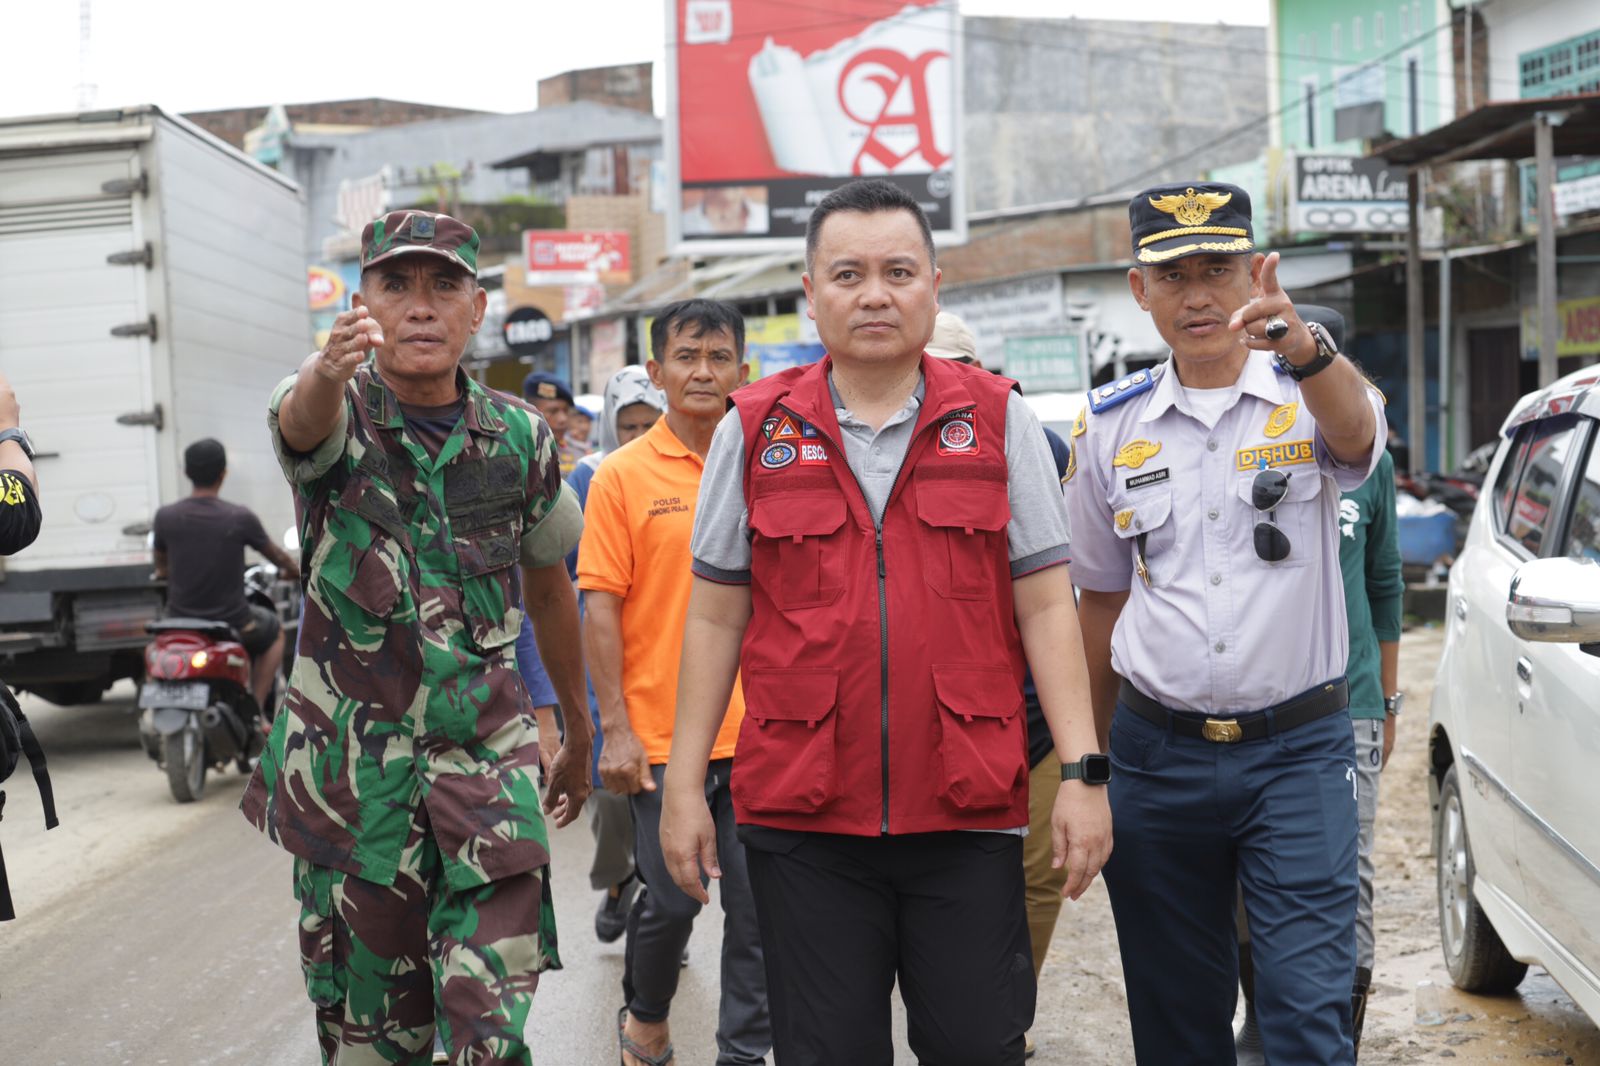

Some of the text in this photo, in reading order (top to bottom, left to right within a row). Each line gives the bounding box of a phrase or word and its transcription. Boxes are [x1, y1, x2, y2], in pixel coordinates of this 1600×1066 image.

[1302, 157, 1353, 173] OPTIK
[1301, 173, 1373, 200] ARENA
[1240, 442, 1313, 465] DISHUB
[1129, 470, 1167, 487] MUHAMMAD ASRI
[653, 497, 681, 506] POLISI
